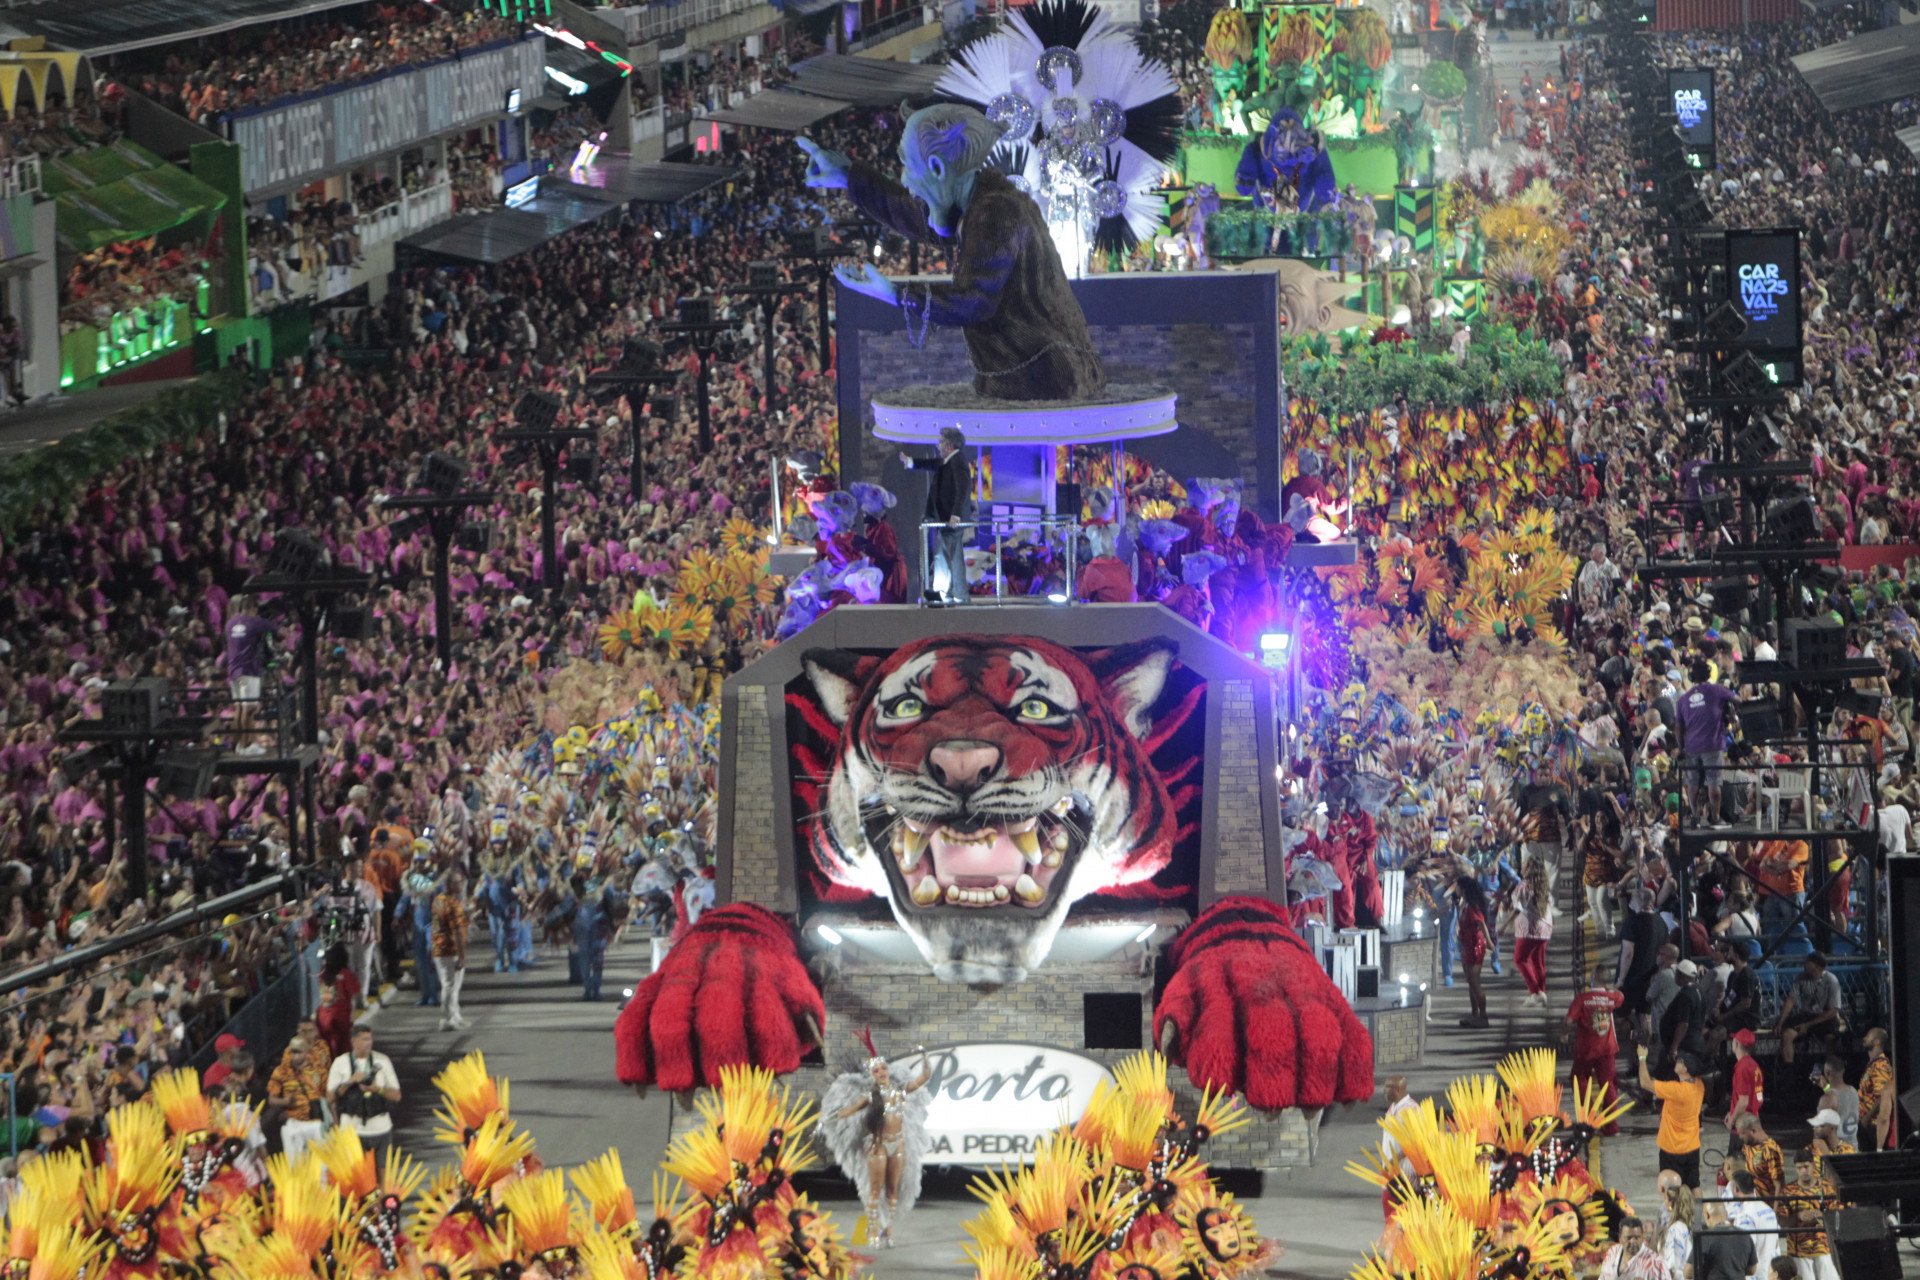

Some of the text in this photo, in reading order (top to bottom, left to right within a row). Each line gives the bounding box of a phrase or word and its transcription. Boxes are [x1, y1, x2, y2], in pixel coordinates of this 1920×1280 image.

[1675, 89, 1701, 101] CAR
[1739, 263, 1779, 280] CAR
[1742, 293, 1779, 309] VAL
[909, 1048, 1073, 1102] Porto
